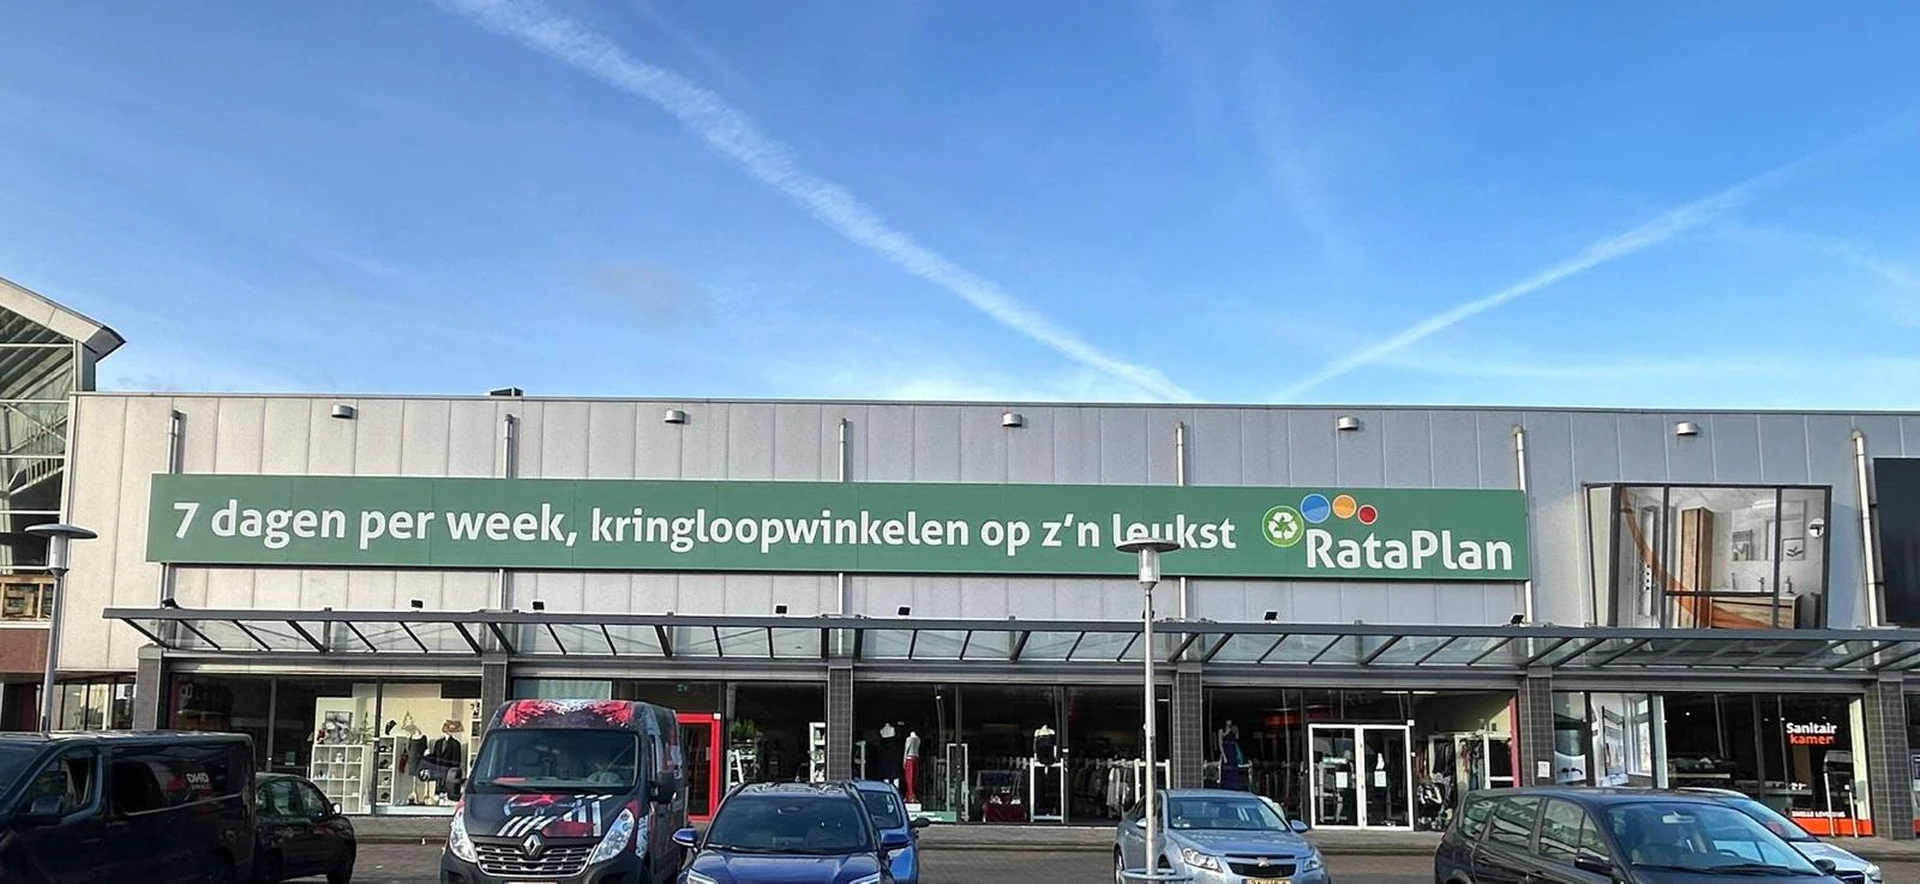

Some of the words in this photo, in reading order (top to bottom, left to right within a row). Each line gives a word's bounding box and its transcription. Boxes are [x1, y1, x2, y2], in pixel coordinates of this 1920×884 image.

[173, 502, 200, 539] 7
[211, 499, 346, 549] dagen
[359, 510, 435, 550] per
[445, 503, 578, 547] week,
[591, 507, 969, 554] kringloopwinkelen
[980, 521, 1031, 556] op
[1041, 513, 1100, 547] z'n
[1112, 513, 1237, 550] leukst
[1306, 528, 1512, 570] RataPlan
[1786, 722, 1838, 734] Sanitair
[1789, 734, 1834, 744] kamer
